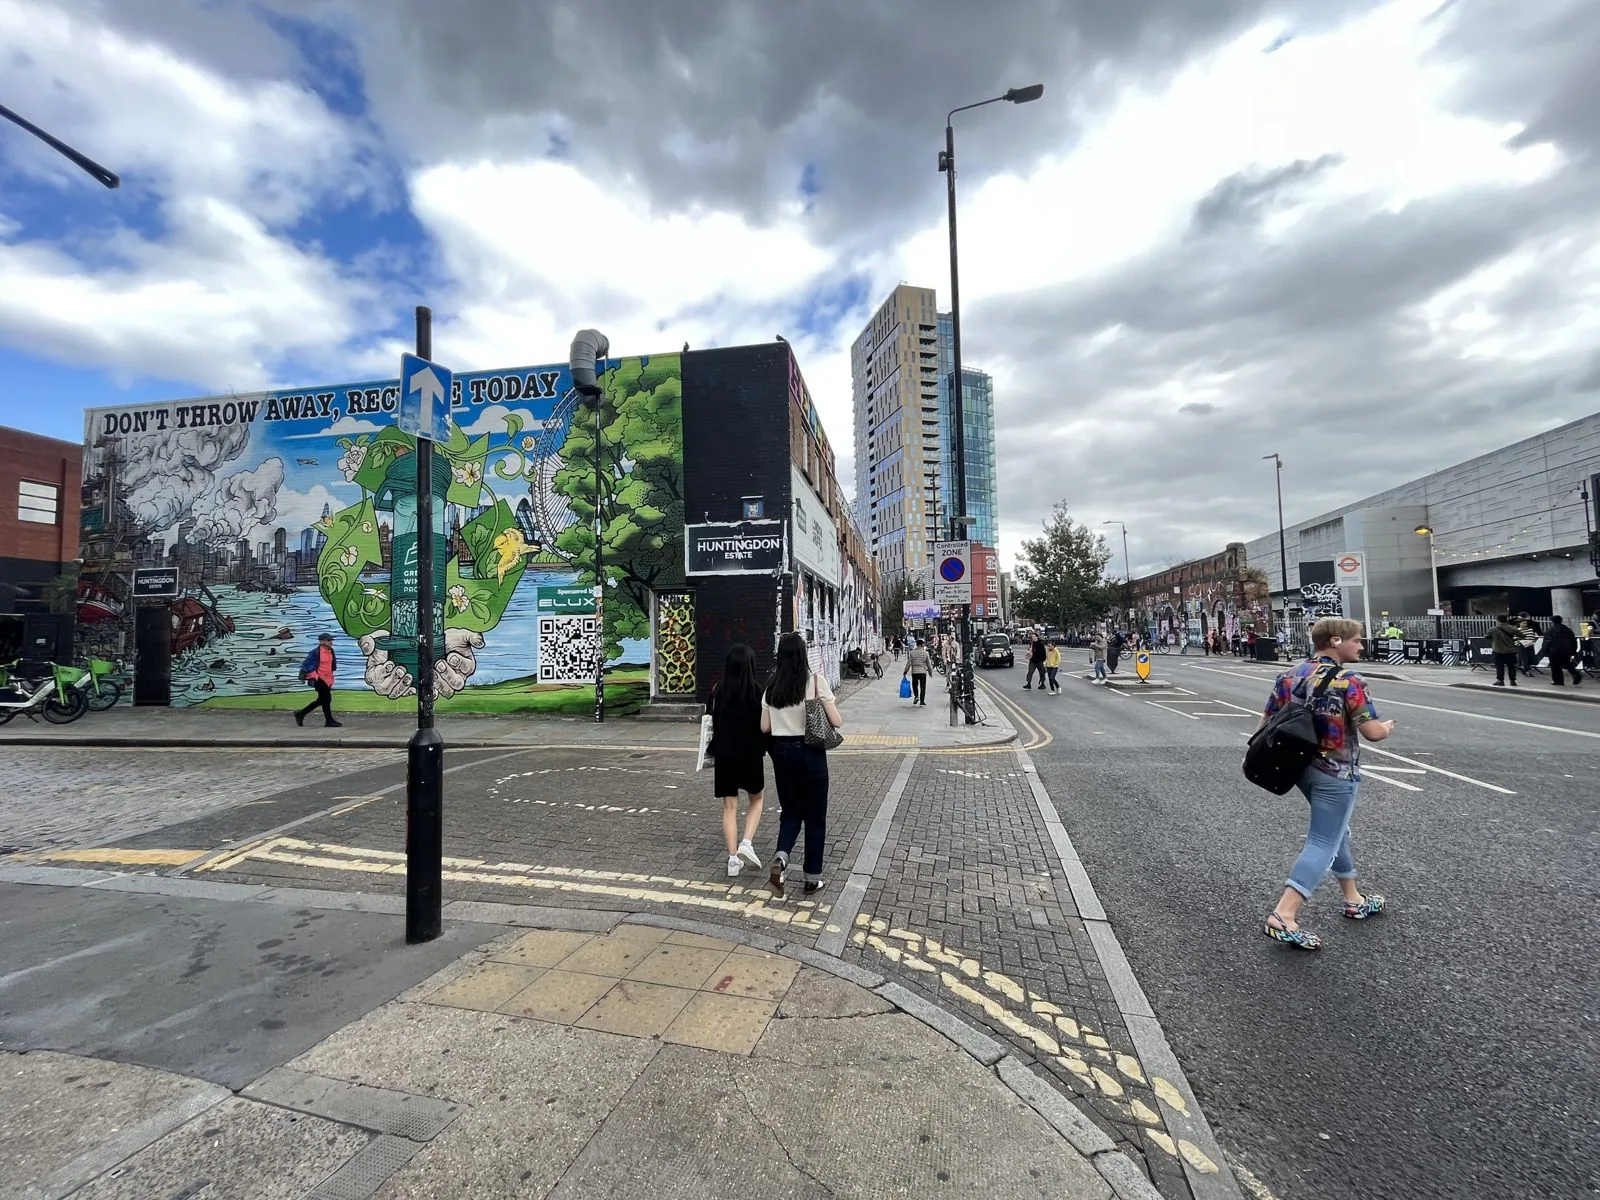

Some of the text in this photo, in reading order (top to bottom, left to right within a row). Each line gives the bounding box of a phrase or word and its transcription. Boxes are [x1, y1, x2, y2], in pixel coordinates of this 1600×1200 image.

[103, 371, 560, 435] DON'T THROW AWAY, RECE TODAY
[697, 538, 780, 552] HUNTINGDON
[724, 551, 753, 559] ESTATE
[557, 587, 588, 595] Sponsored
[538, 596, 596, 607] ELUX
